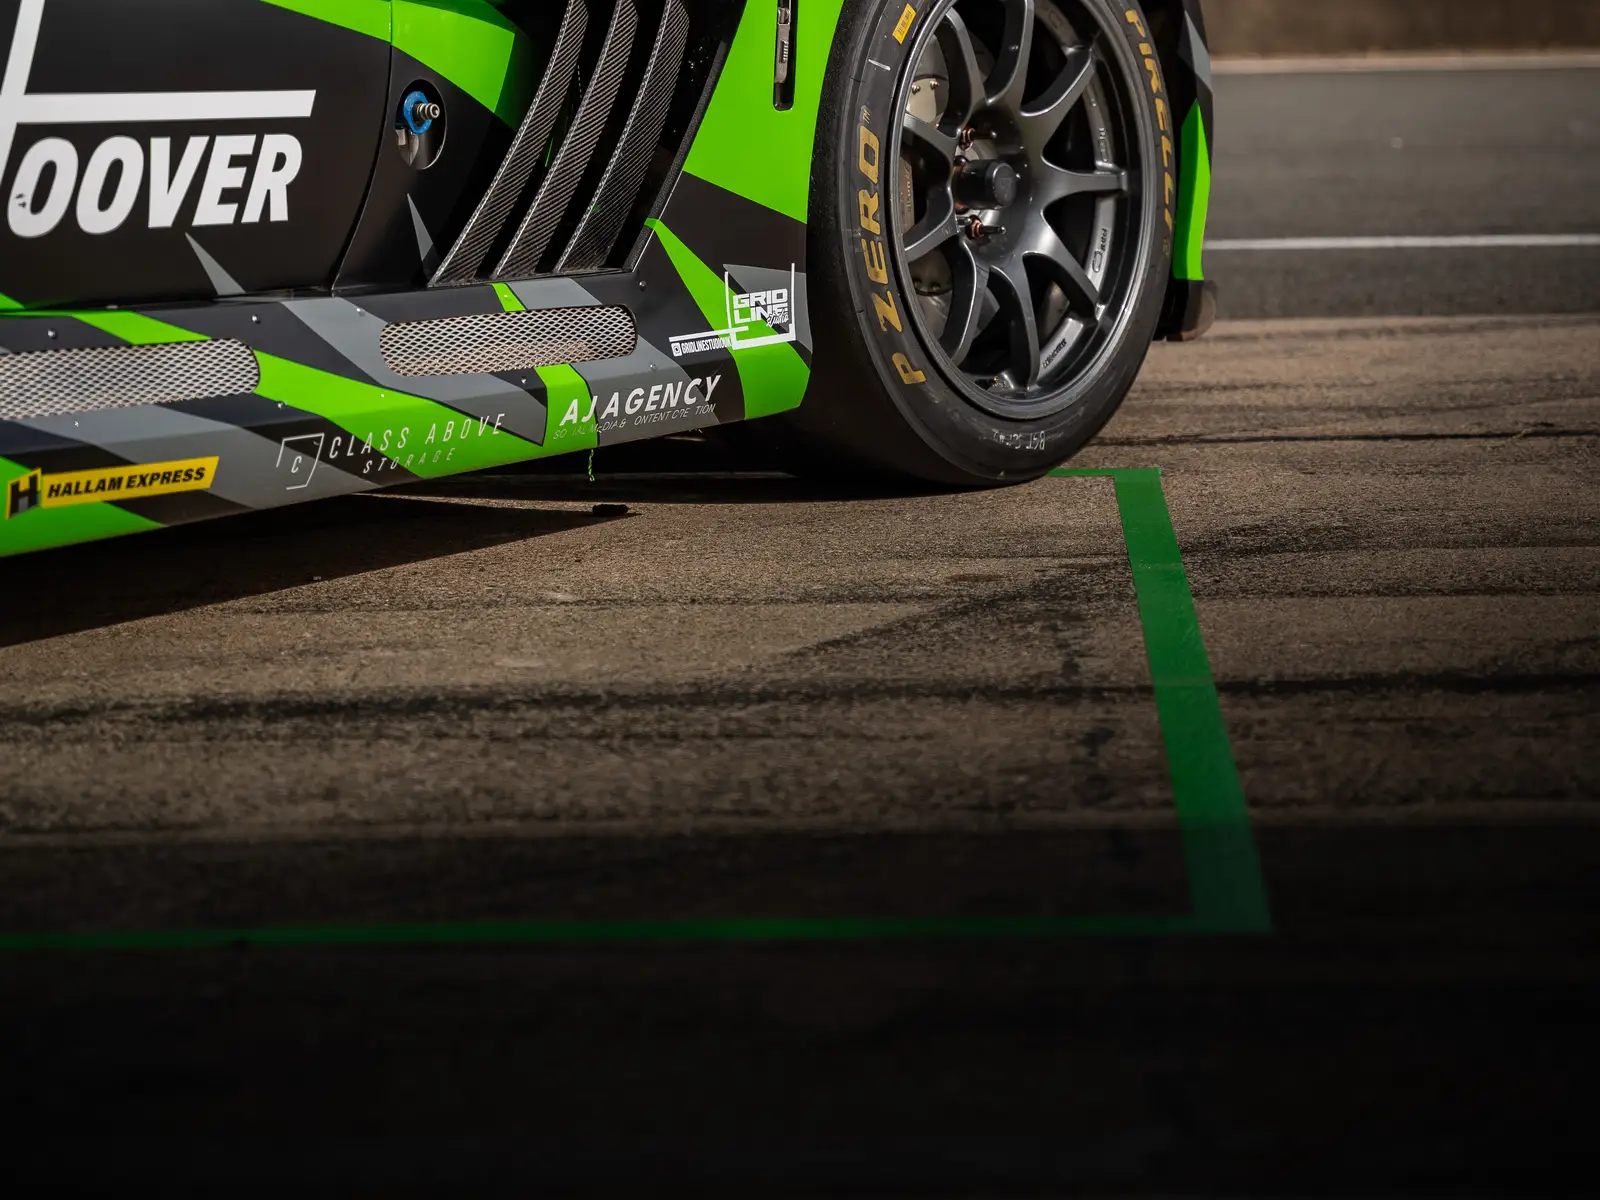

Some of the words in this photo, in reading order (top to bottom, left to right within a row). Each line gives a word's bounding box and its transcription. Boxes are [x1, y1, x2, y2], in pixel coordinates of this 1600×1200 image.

[1125, 9, 1174, 232] PIRELLI
[858, 124, 903, 333] ZERO
[733, 288, 788, 309] GRID
[733, 303, 788, 324] LINE
[892, 352, 927, 385] P
[329, 427, 410, 460] CLASS
[425, 413, 505, 445] ABOVE
[553, 425, 586, 440] SOIAL
[634, 410, 670, 426] ONTENT
[363, 448, 456, 474] STORAGE
[47, 475, 122, 499] HALLAM
[125, 467, 206, 489] EXPRESS
